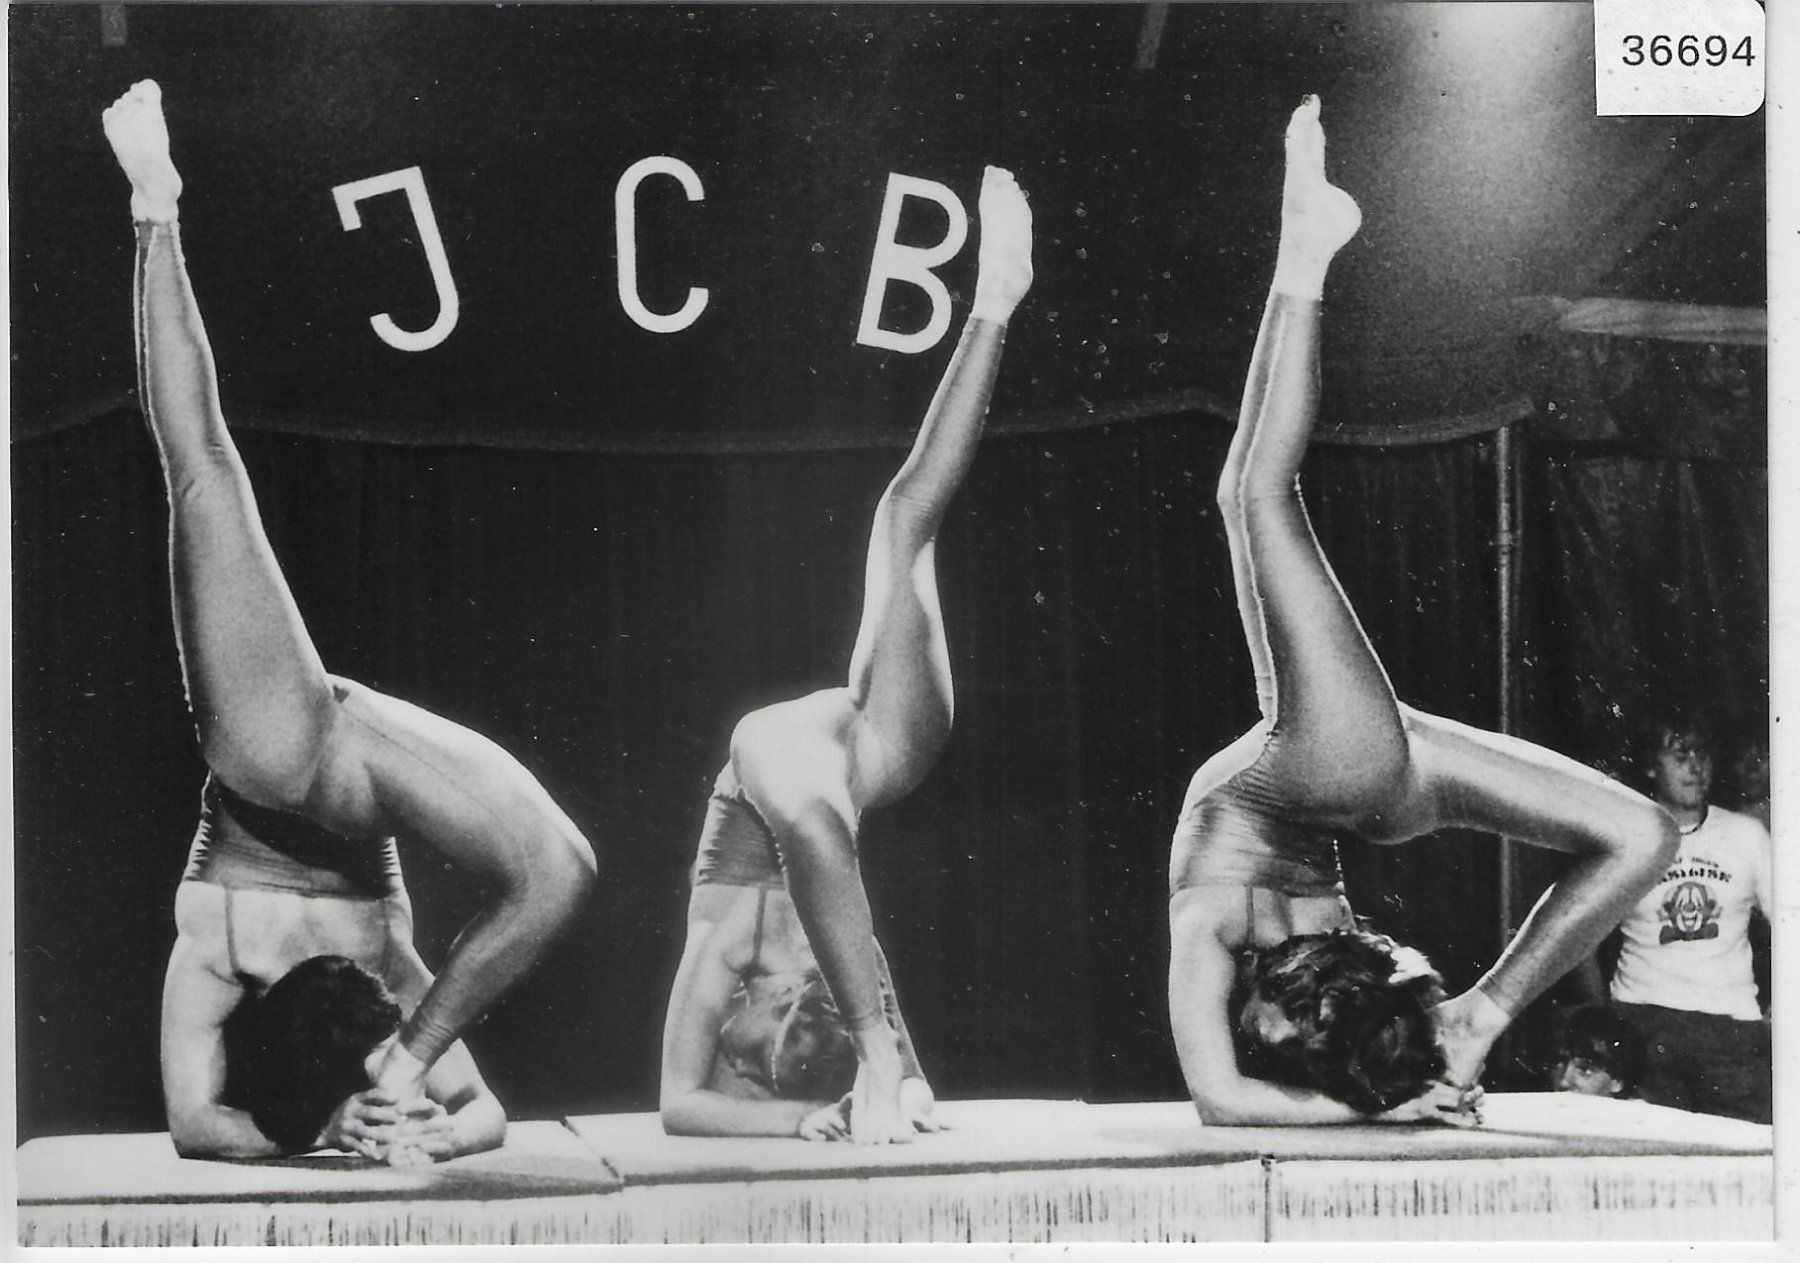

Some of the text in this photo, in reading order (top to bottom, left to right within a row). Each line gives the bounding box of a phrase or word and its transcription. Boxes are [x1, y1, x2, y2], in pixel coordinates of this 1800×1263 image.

[332, 156, 969, 354] J C B
